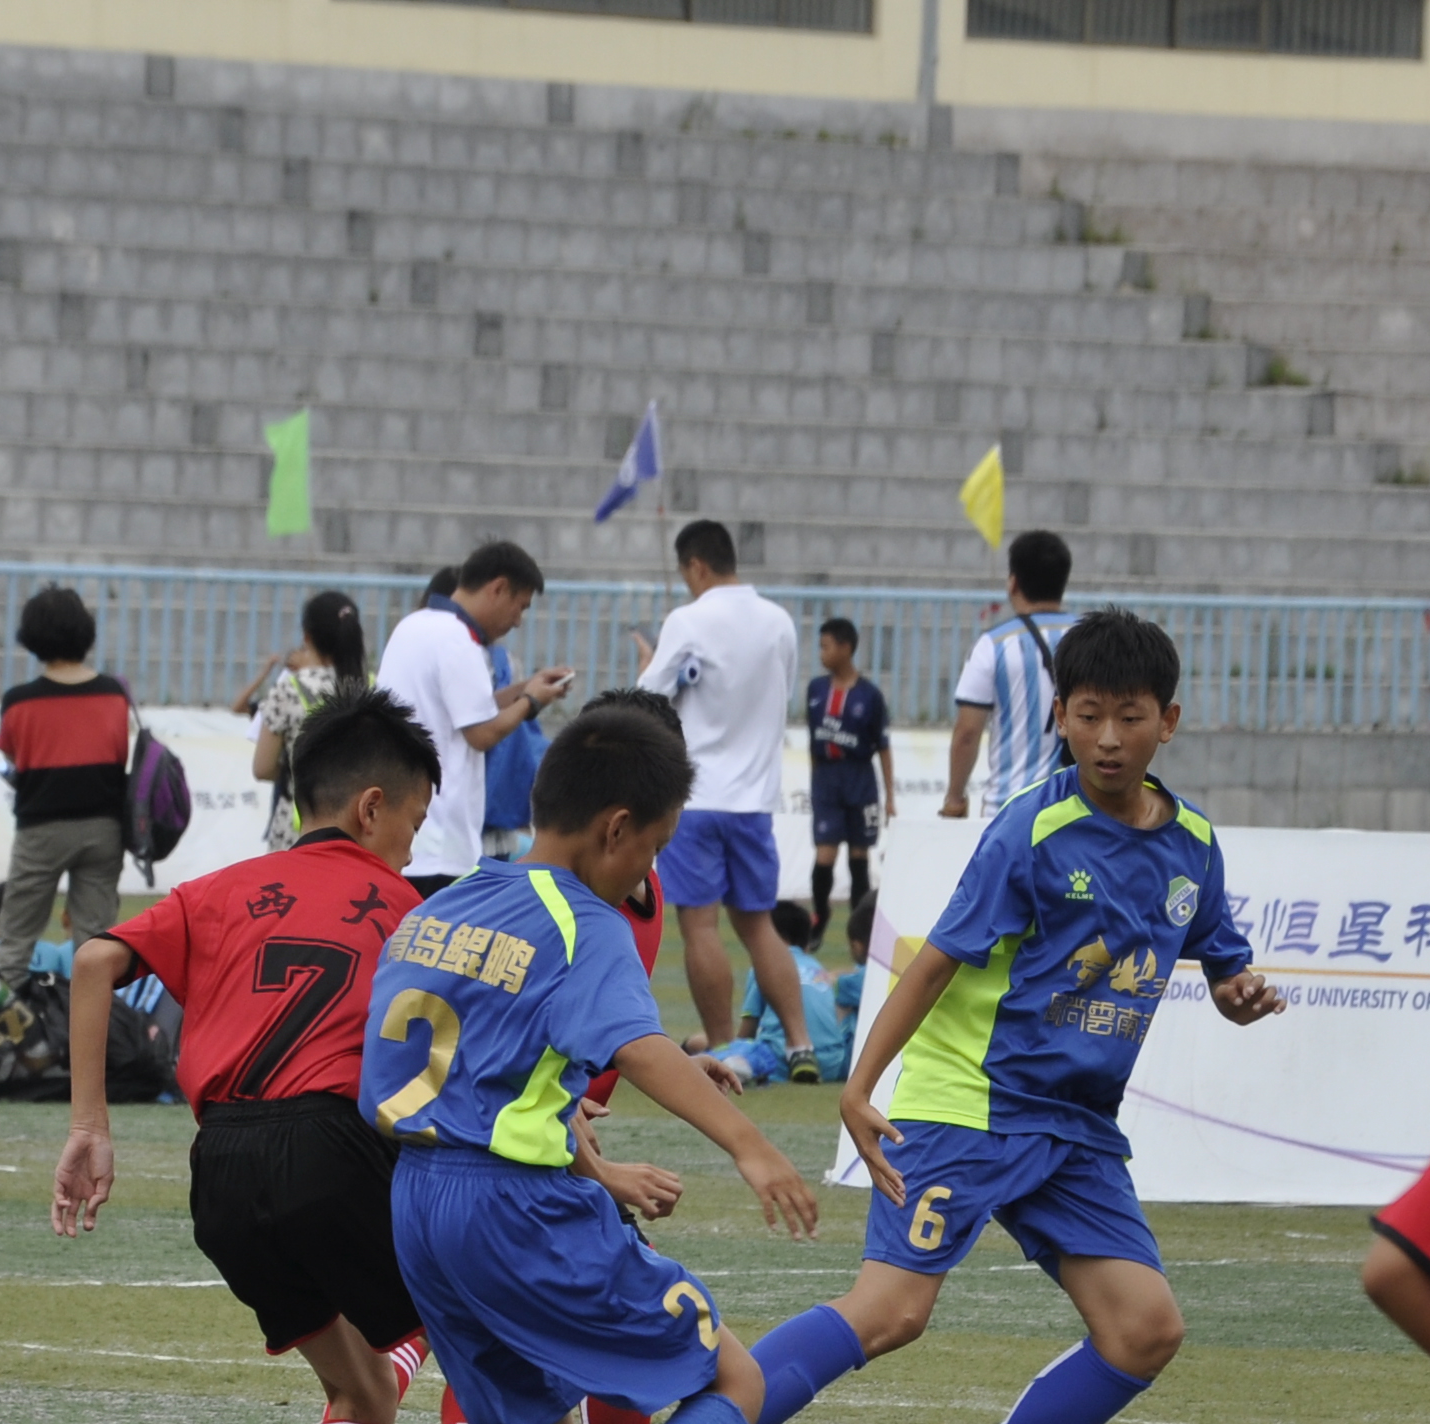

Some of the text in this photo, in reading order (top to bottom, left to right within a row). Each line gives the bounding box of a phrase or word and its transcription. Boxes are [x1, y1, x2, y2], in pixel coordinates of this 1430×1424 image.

[1065, 892, 1094, 900] KELME
[386, 913, 537, 995] 青岛鲲鹏
[227, 935, 362, 1102] 7
[1307, 985, 1409, 1010] UNIVERSITY
[376, 987, 461, 1147] 2
[908, 1185, 953, 1250] 6
[662, 1280, 721, 1352] 2
